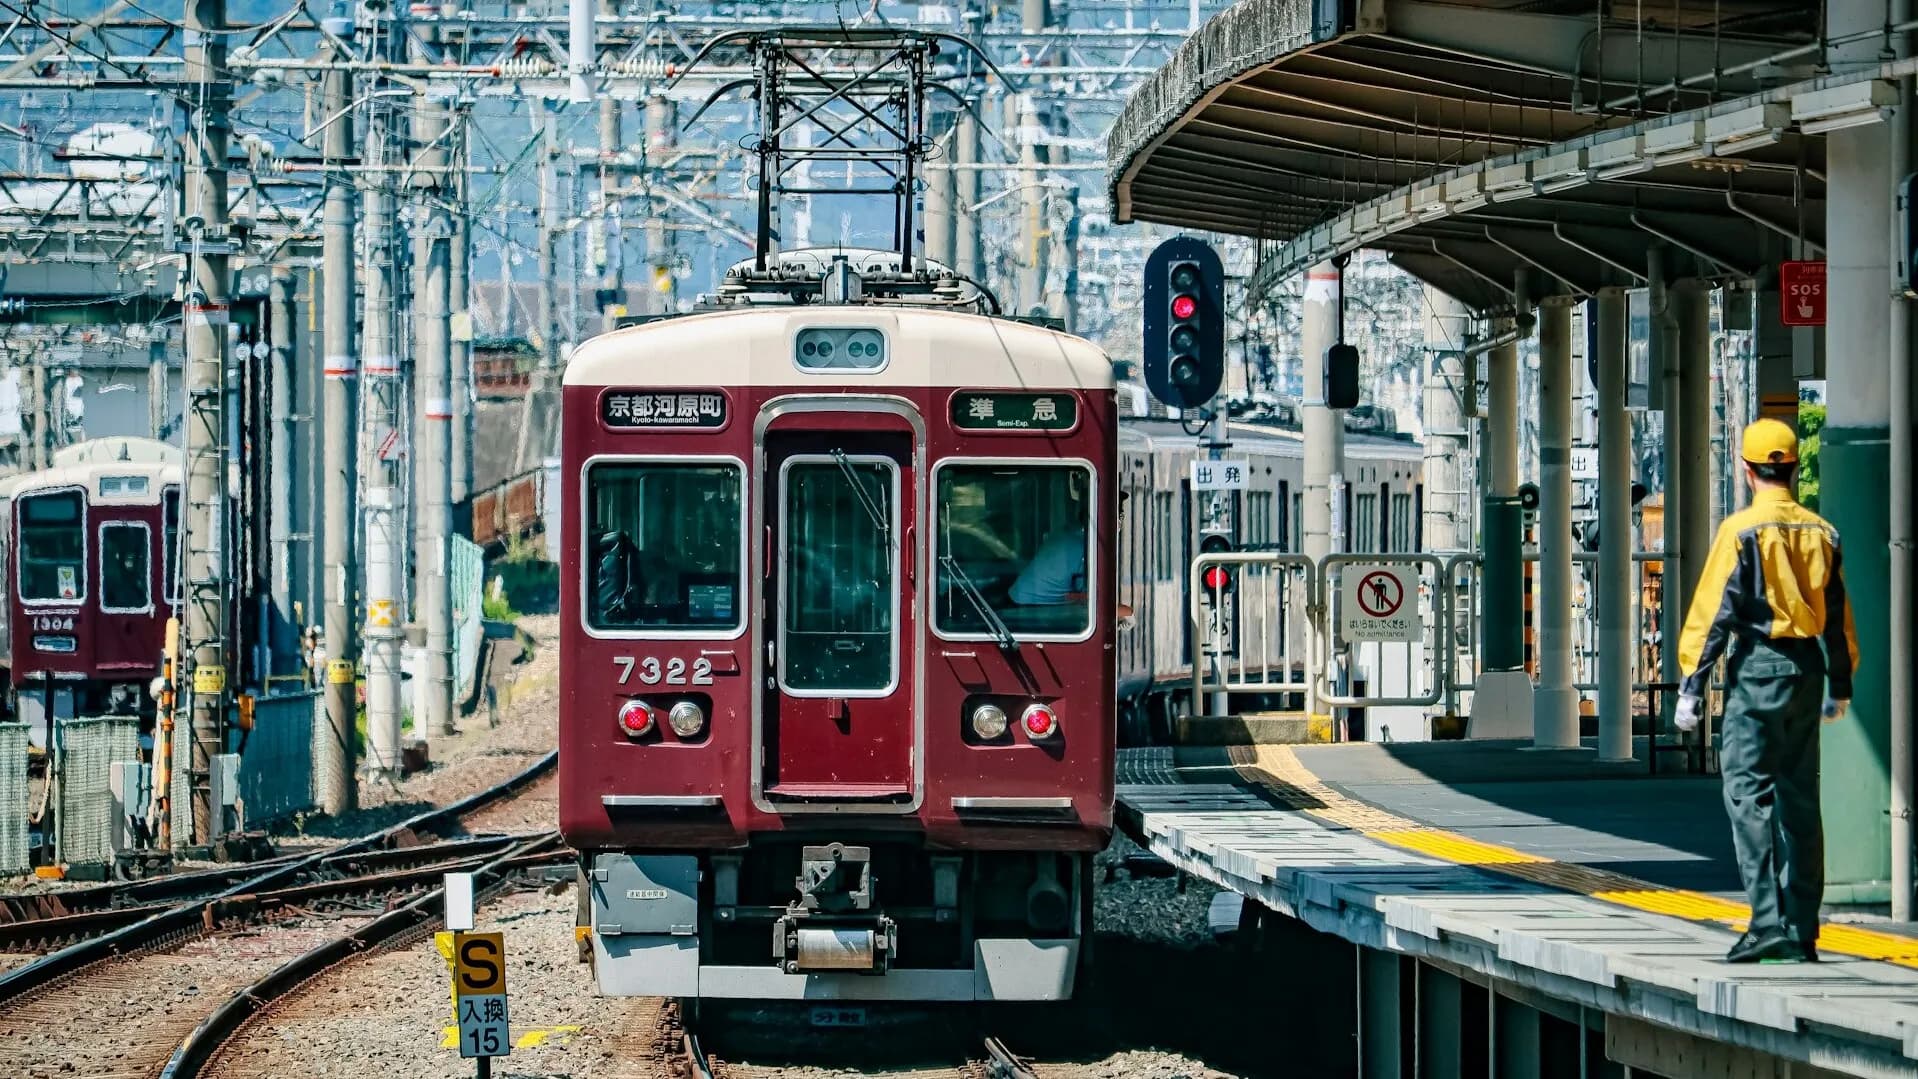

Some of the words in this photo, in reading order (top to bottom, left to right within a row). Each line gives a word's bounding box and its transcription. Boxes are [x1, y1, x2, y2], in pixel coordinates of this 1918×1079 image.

[1791, 284, 1820, 295] SOS
[608, 395, 722, 417] 京都河原町
[1197, 466, 1240, 484] 出発
[613, 656, 713, 685] 7322
[461, 939, 499, 989] S
[463, 998, 504, 1024] 入換
[468, 1027, 499, 1054] 15
